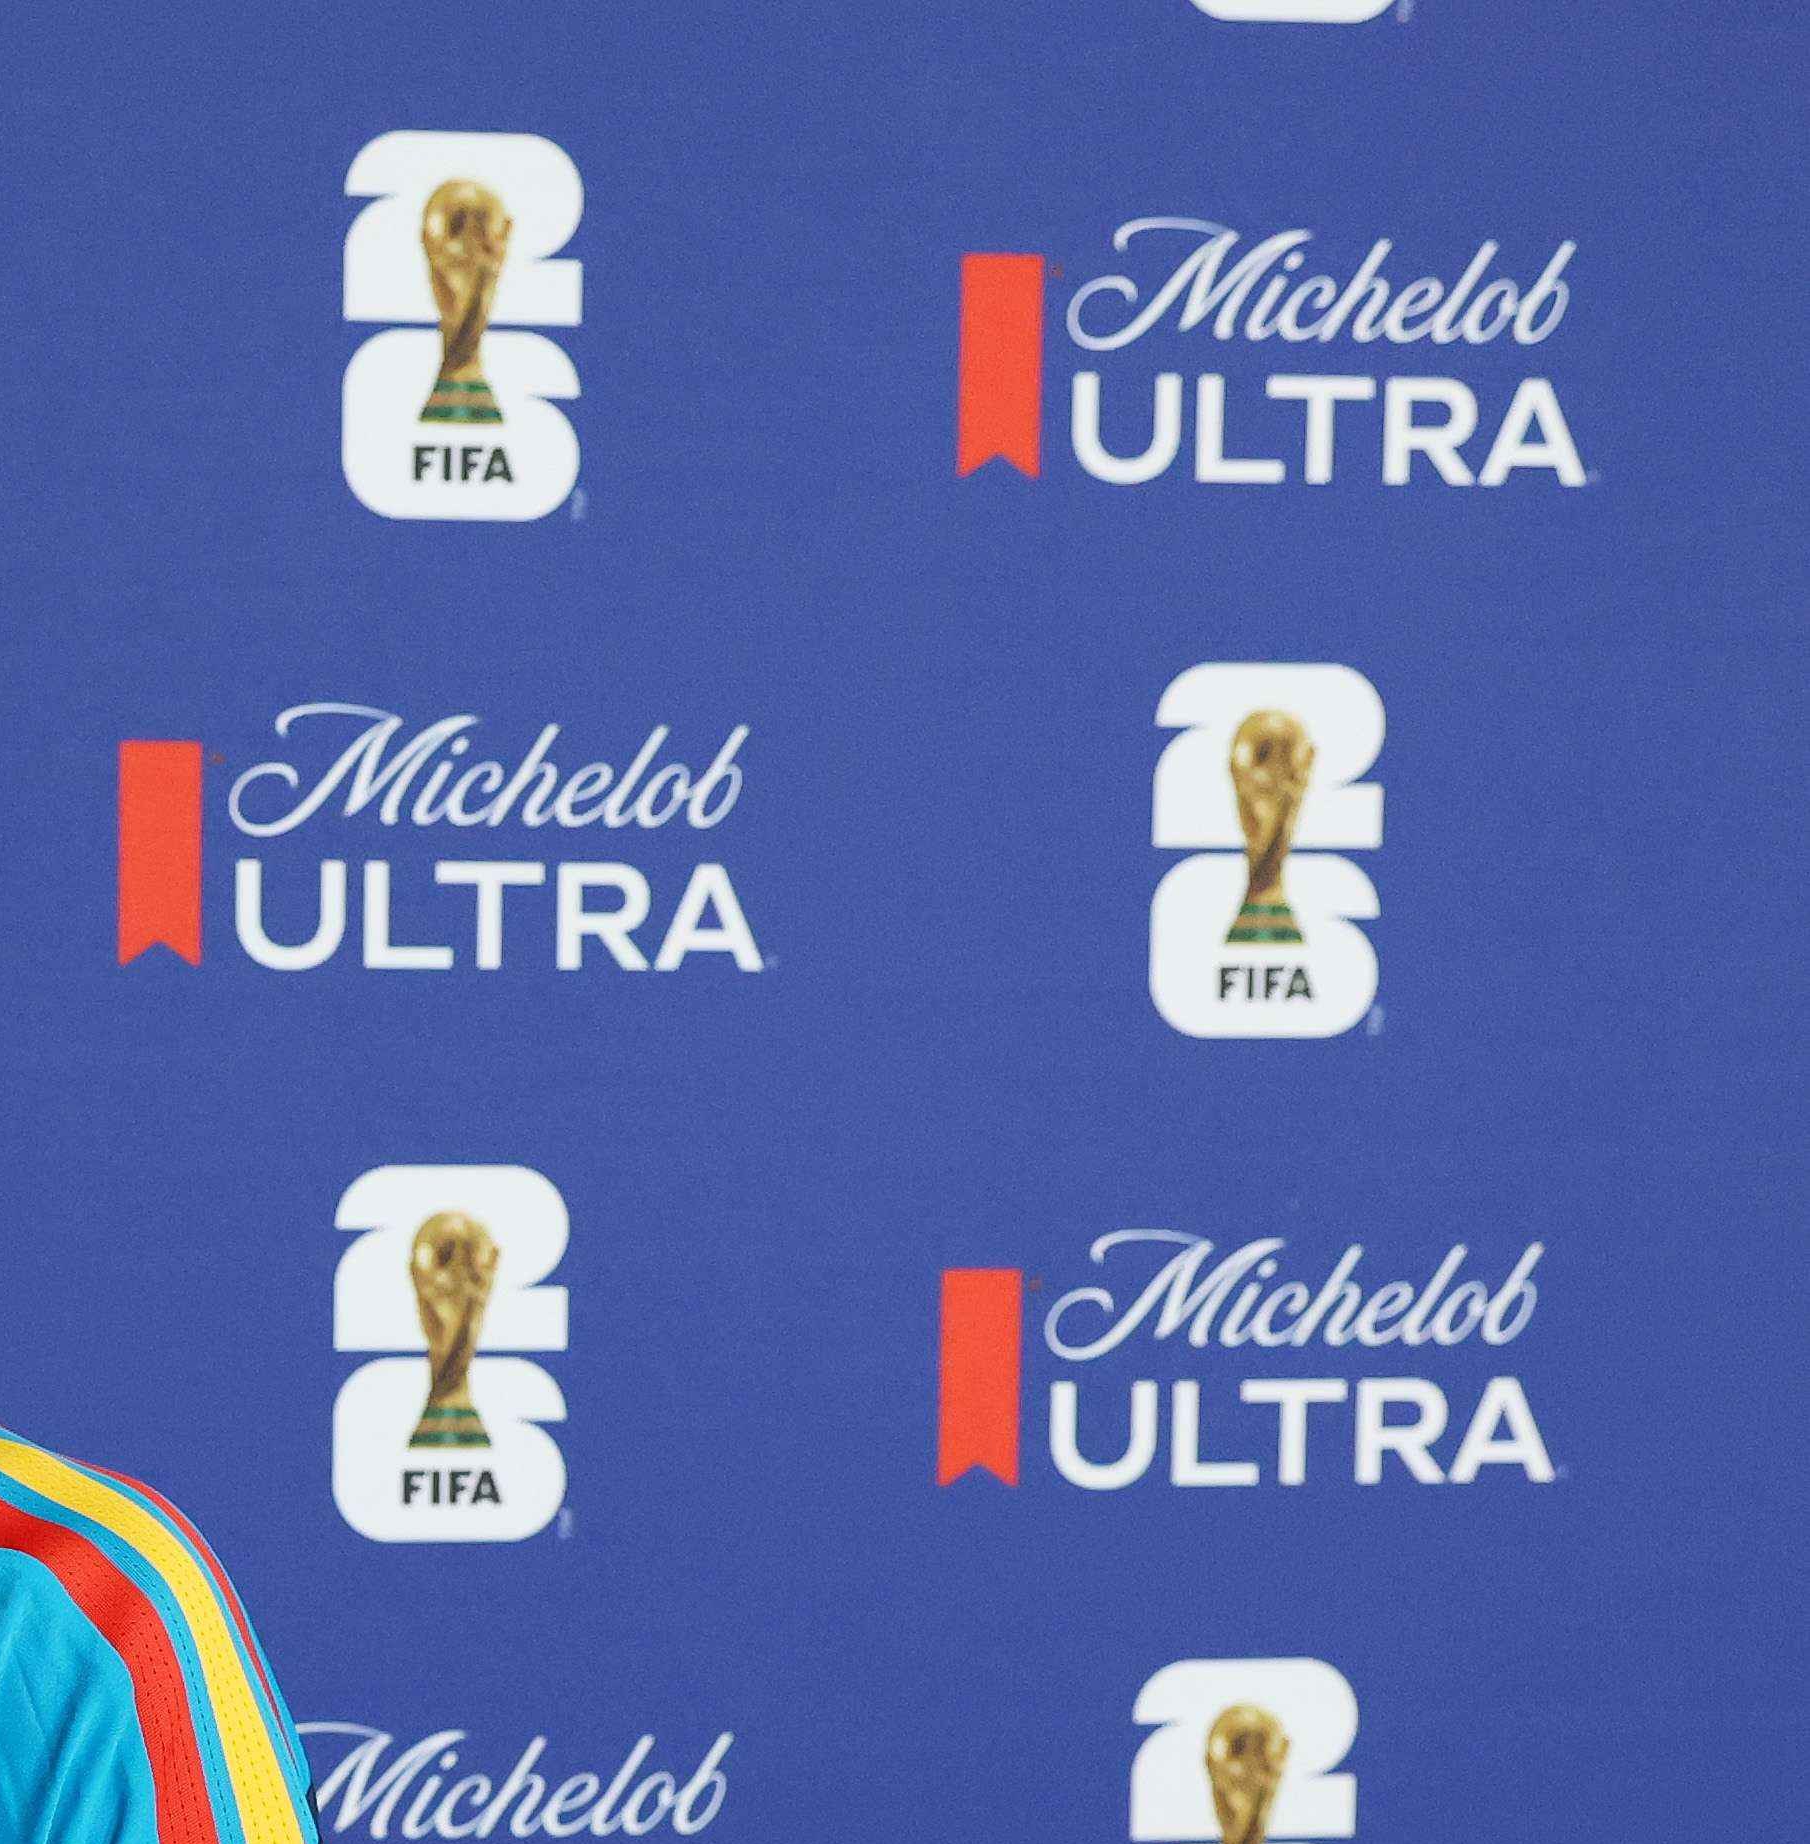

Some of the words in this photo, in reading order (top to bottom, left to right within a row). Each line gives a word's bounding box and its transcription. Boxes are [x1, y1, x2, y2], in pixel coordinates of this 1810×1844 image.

[1067, 217, 1576, 351] Michelob
[413, 446, 513, 483] FIFA
[1072, 372, 1586, 487] ULTRA
[229, 703, 749, 837] Michelob
[236, 859, 764, 972] ULTRA
[1219, 966, 1313, 1000] FIFA
[1044, 1229, 1544, 1361] Michelob
[402, 1470, 501, 1505] FIFA
[1050, 1377, 1555, 1490] ULTRA
